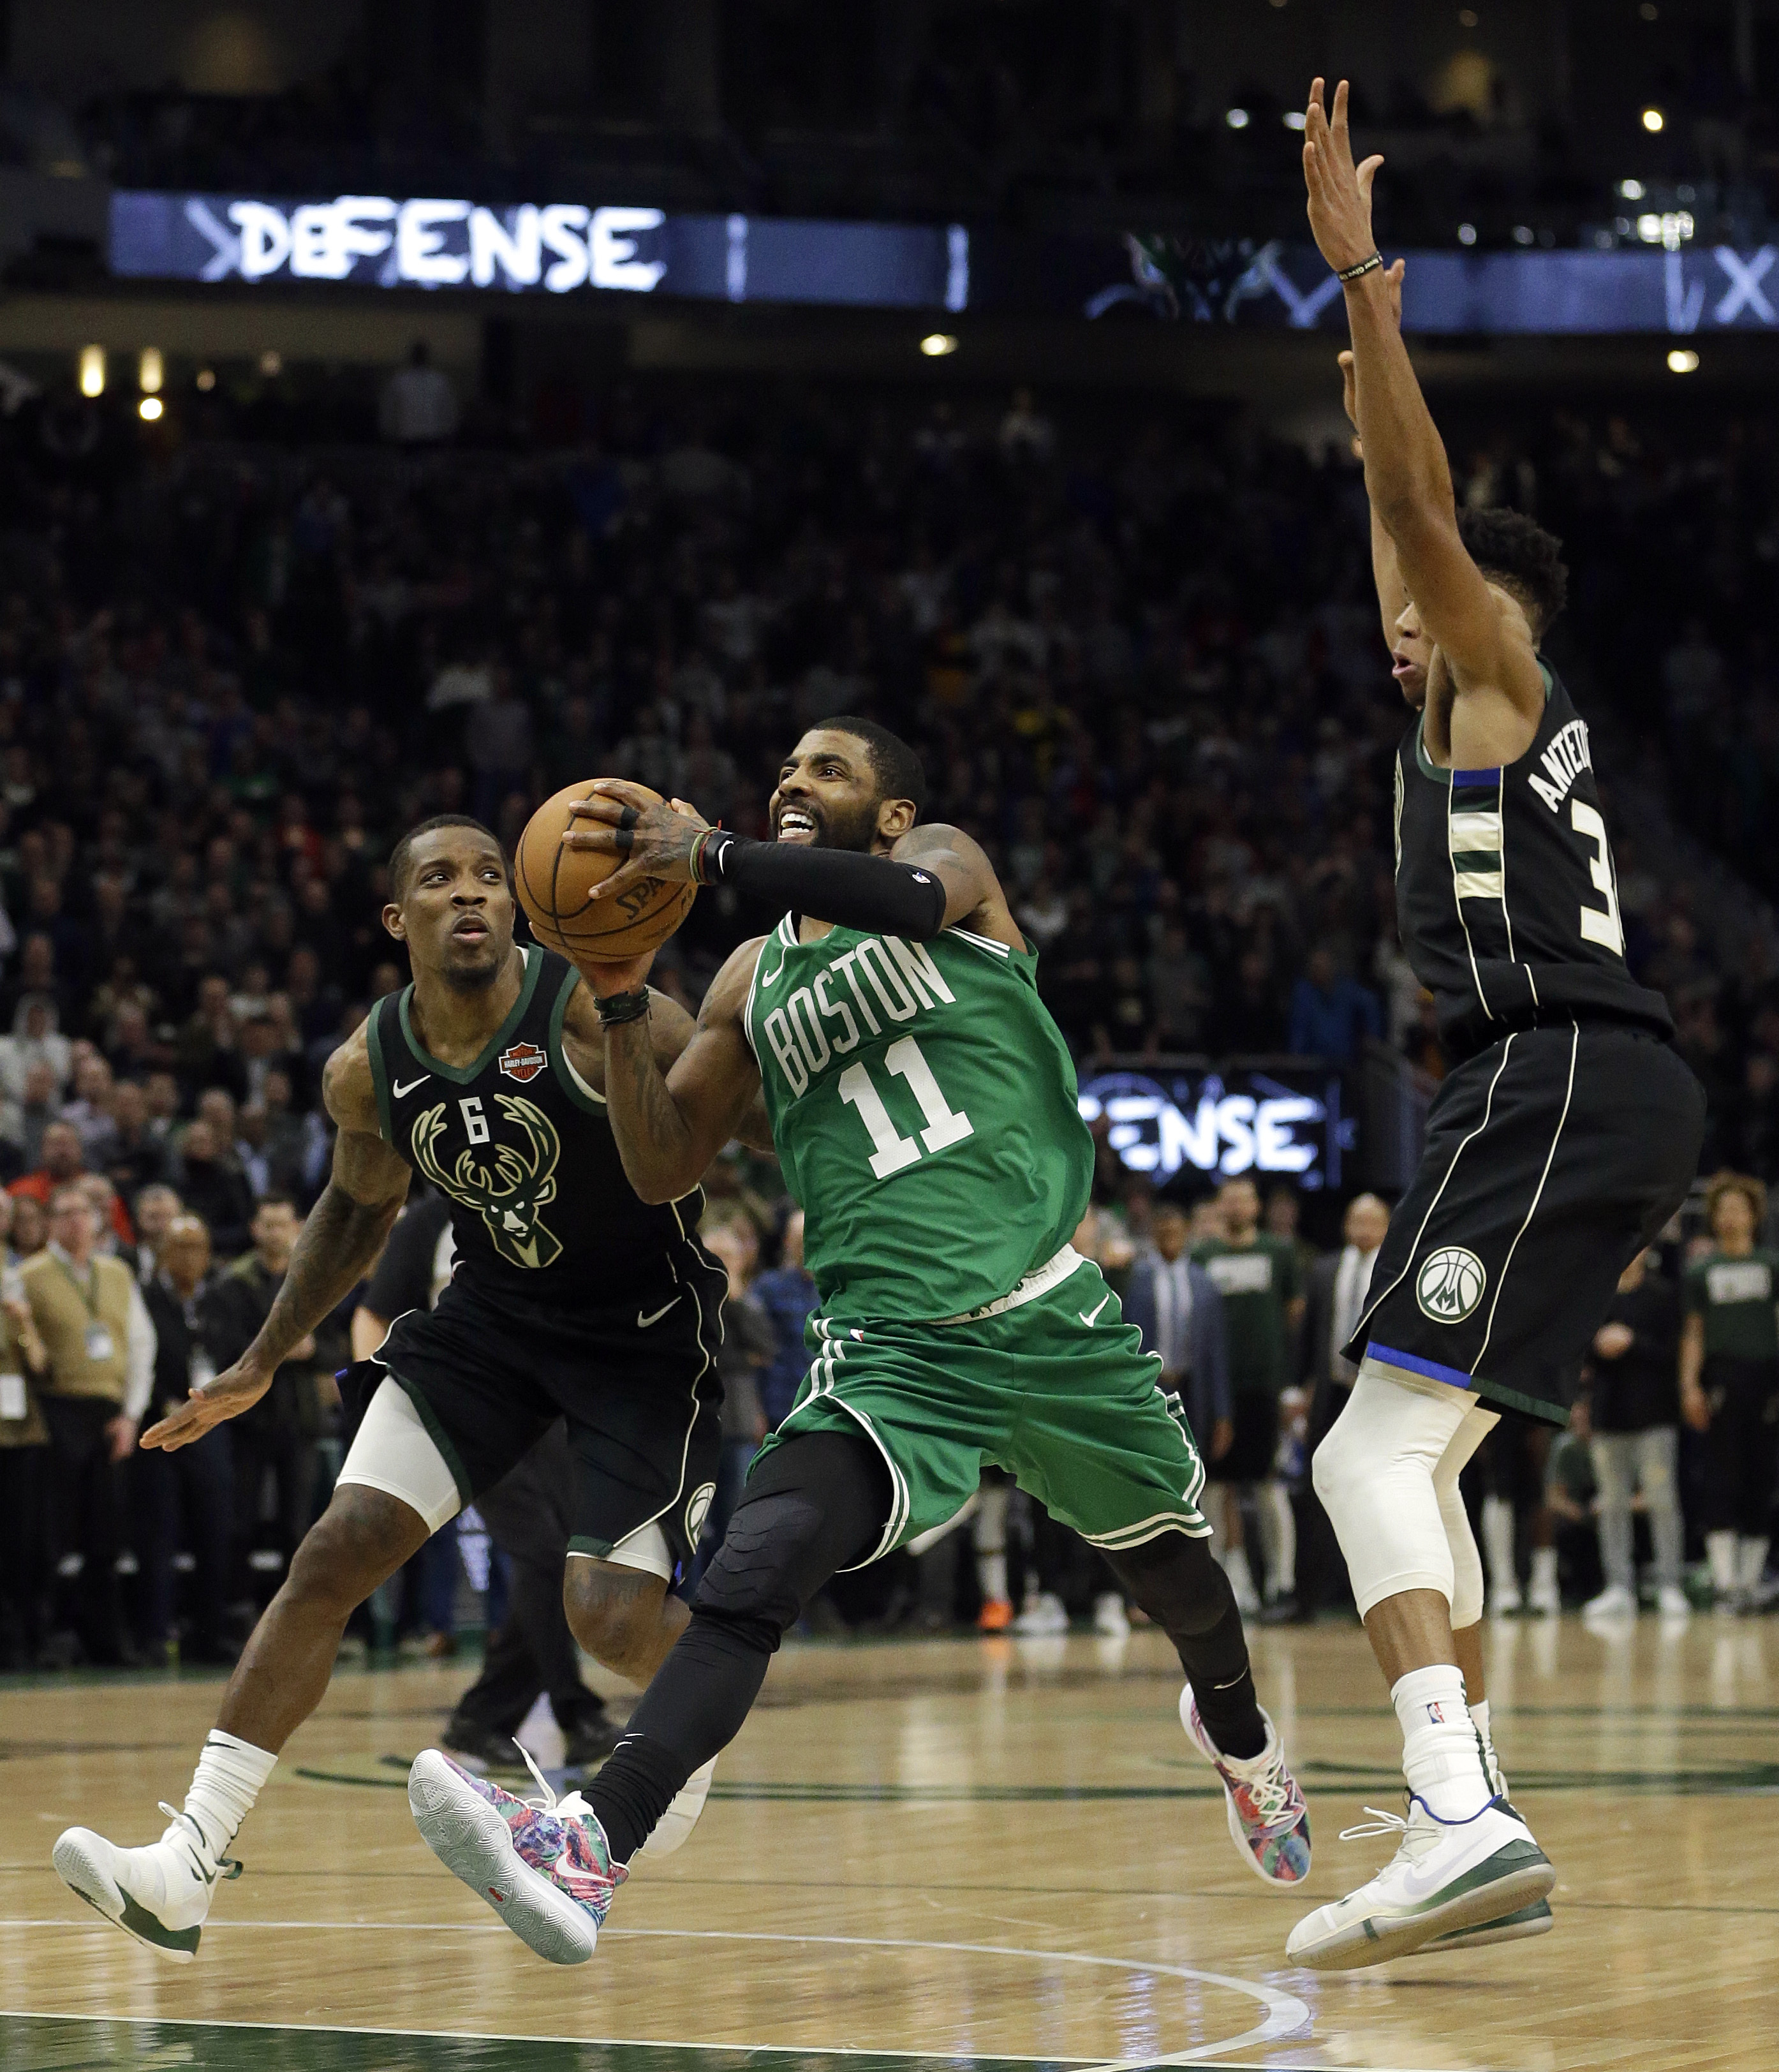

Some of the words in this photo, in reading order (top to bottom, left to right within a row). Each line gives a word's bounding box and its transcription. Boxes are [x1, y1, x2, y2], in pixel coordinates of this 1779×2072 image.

[228, 194, 667, 293] DEFENSE
[616, 875, 666, 920] SPA
[1570, 798, 1626, 958] 3
[504, 1056, 543, 1069] HARLEY-DAVIDSON
[764, 935, 956, 1099] BOSTON
[458, 1097, 490, 1144] 6
[838, 1035, 974, 1180] 11
[1078, 1093, 1327, 1176] ENSE
